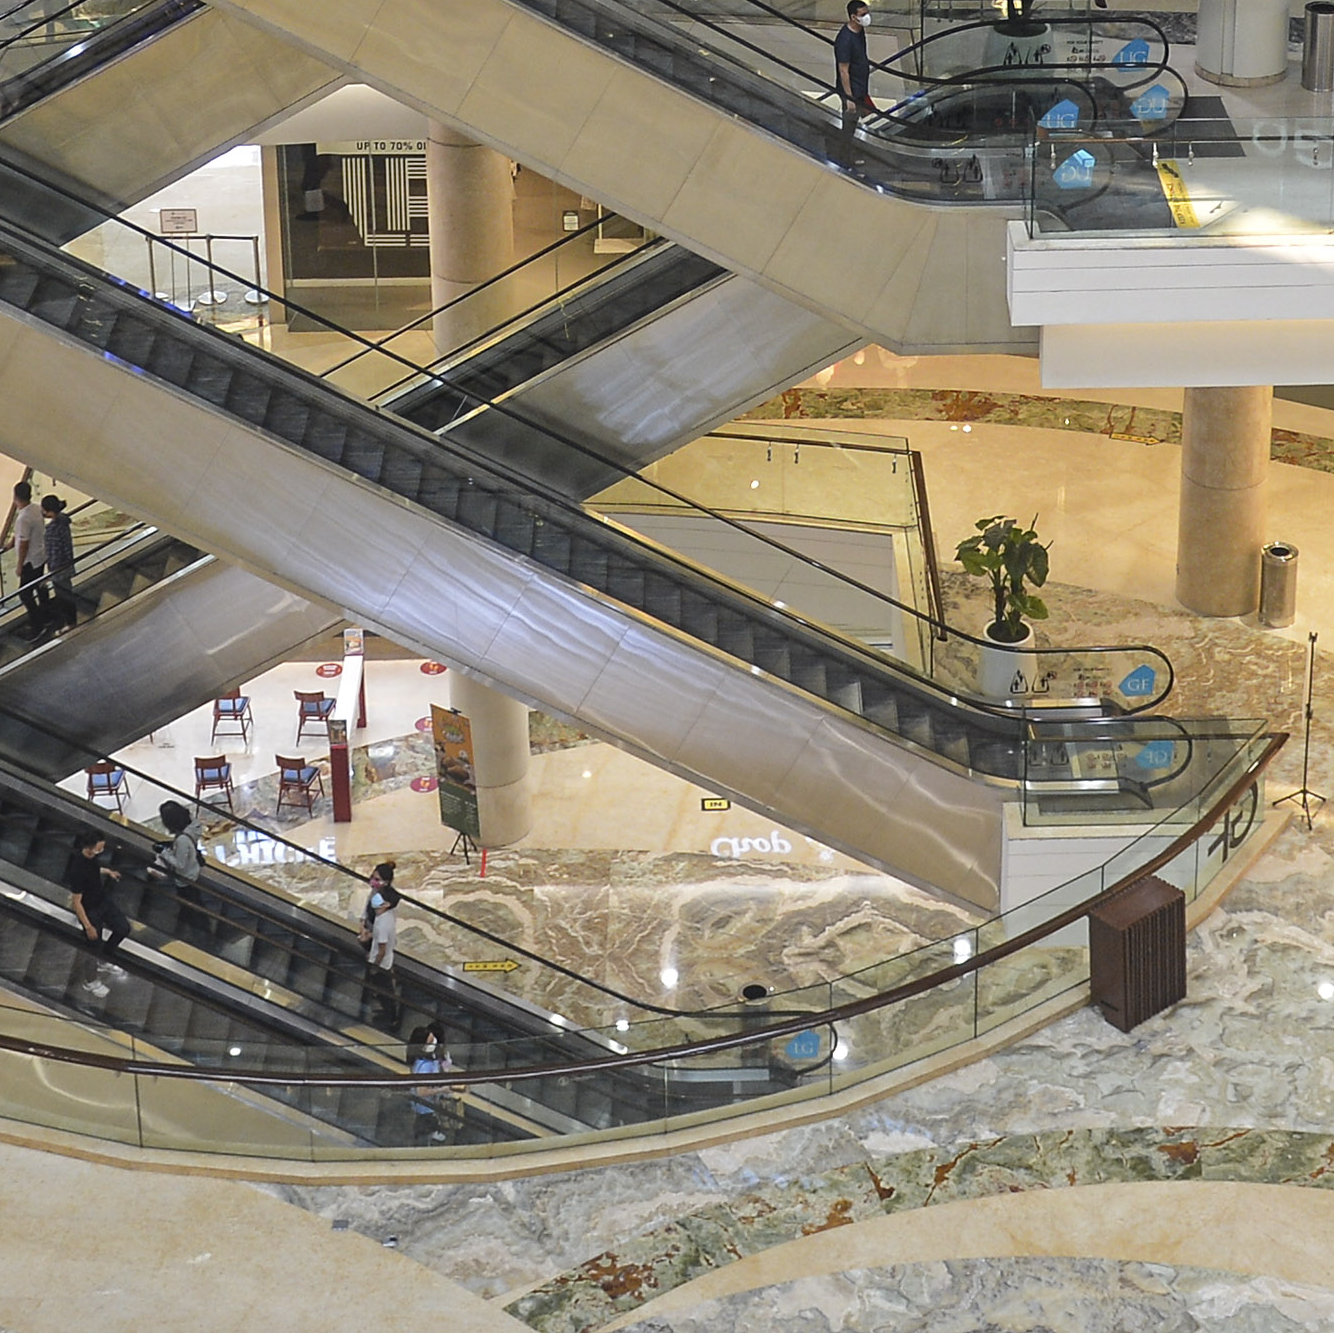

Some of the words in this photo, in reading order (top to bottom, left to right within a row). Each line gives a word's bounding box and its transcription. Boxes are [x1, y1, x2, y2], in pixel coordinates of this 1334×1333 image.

[356, 141, 370, 150] UP
[374, 140, 387, 150] TO
[390, 139, 413, 150] 70%
[416, 139, 427, 150] O
[1127, 678, 1150, 692] GF
